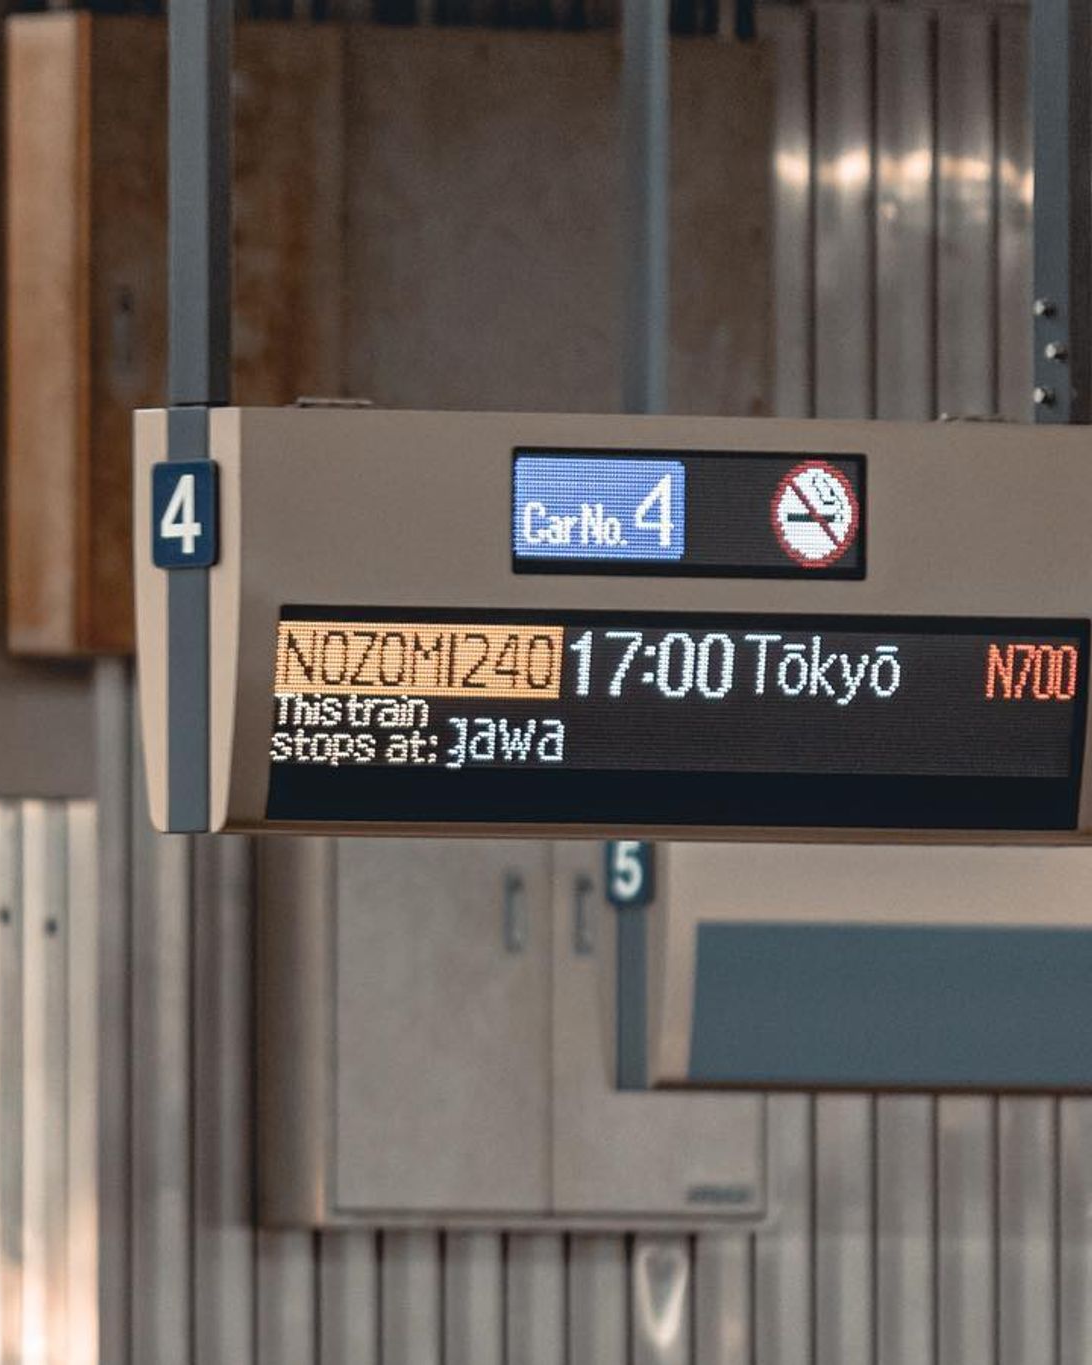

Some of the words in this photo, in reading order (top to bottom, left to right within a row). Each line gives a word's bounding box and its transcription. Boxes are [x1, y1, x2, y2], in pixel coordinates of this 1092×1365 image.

[160, 473, 202, 554] 4
[634, 473, 675, 548] 4
[568, 630, 736, 699] 17:00
[744, 633, 902, 704] Tōkyō
[984, 642, 1081, 701] N700
[273, 693, 342, 727] This
[346, 693, 430, 728] train
[269, 728, 377, 767] stops
[385, 730, 439, 764] at:
[614, 841, 643, 900] 5
